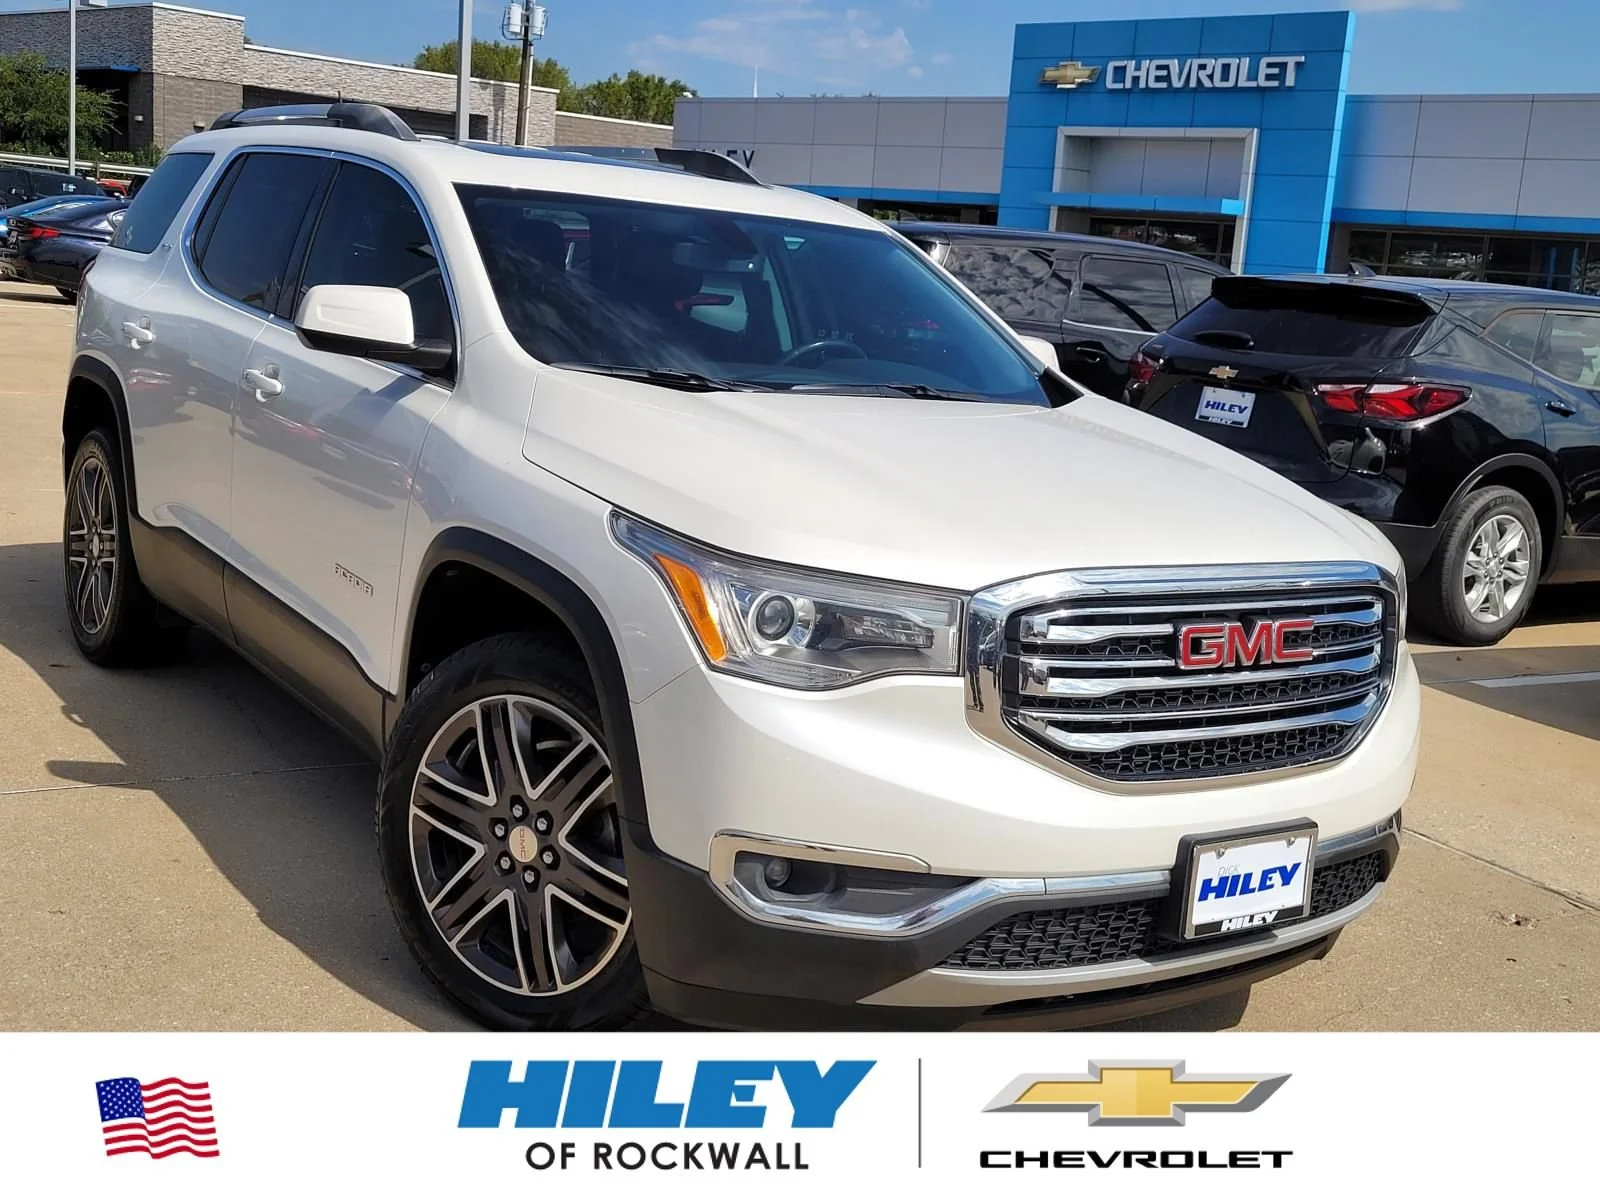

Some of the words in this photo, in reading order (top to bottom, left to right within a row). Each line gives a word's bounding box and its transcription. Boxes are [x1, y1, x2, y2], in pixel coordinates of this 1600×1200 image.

[1105, 55, 1305, 89] CHEVROLET
[1205, 400, 1248, 414] HILEY
[1178, 618, 1314, 670] GMC
[1198, 862, 1302, 902] HILEY
[1220, 910, 1279, 932] HILEY
